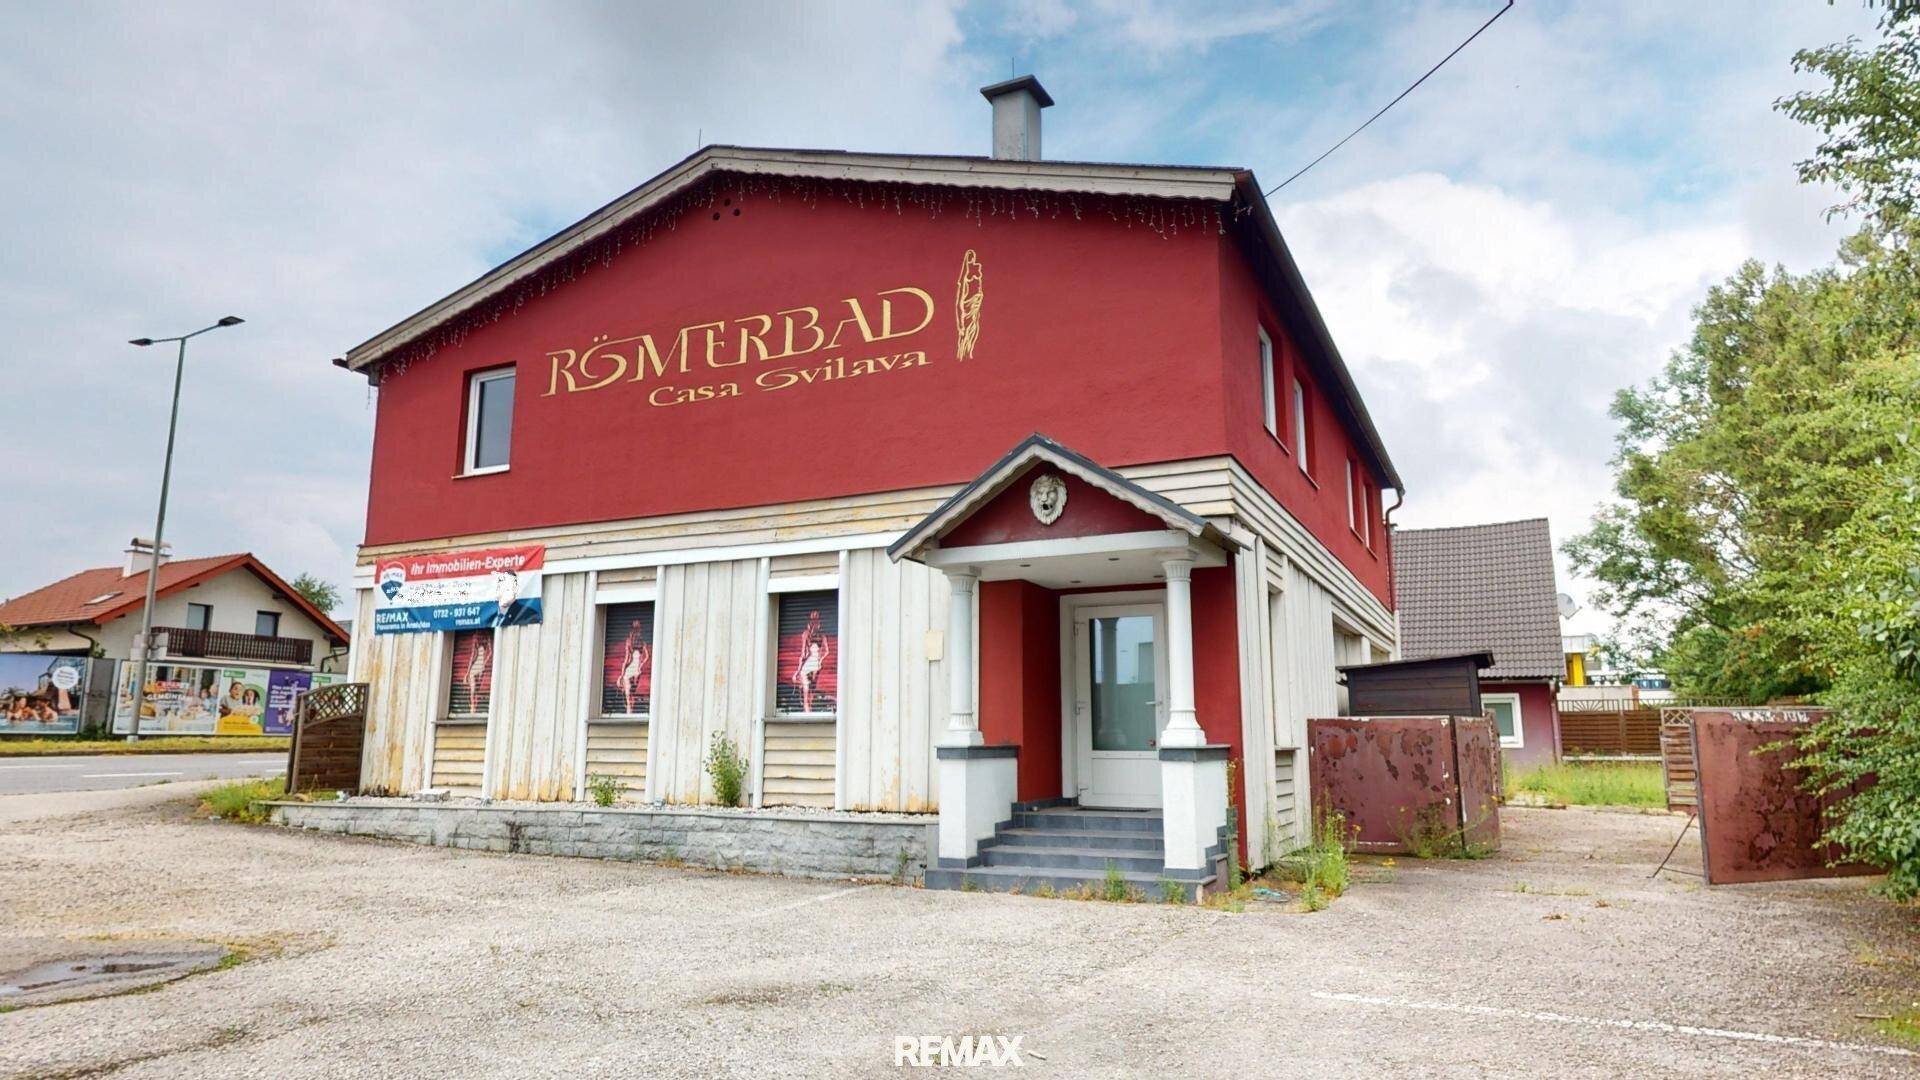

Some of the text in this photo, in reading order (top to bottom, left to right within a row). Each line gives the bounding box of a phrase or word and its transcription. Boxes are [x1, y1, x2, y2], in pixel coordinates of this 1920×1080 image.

[540, 287, 935, 398] RÖMERBAD
[648, 380, 743, 407] Casa
[410, 555, 525, 576] Ihr Immobilien-Experte
[376, 612, 409, 624] RE/MAX
[433, 608, 449, 619] 0732
[467, 606, 480, 616] 647
